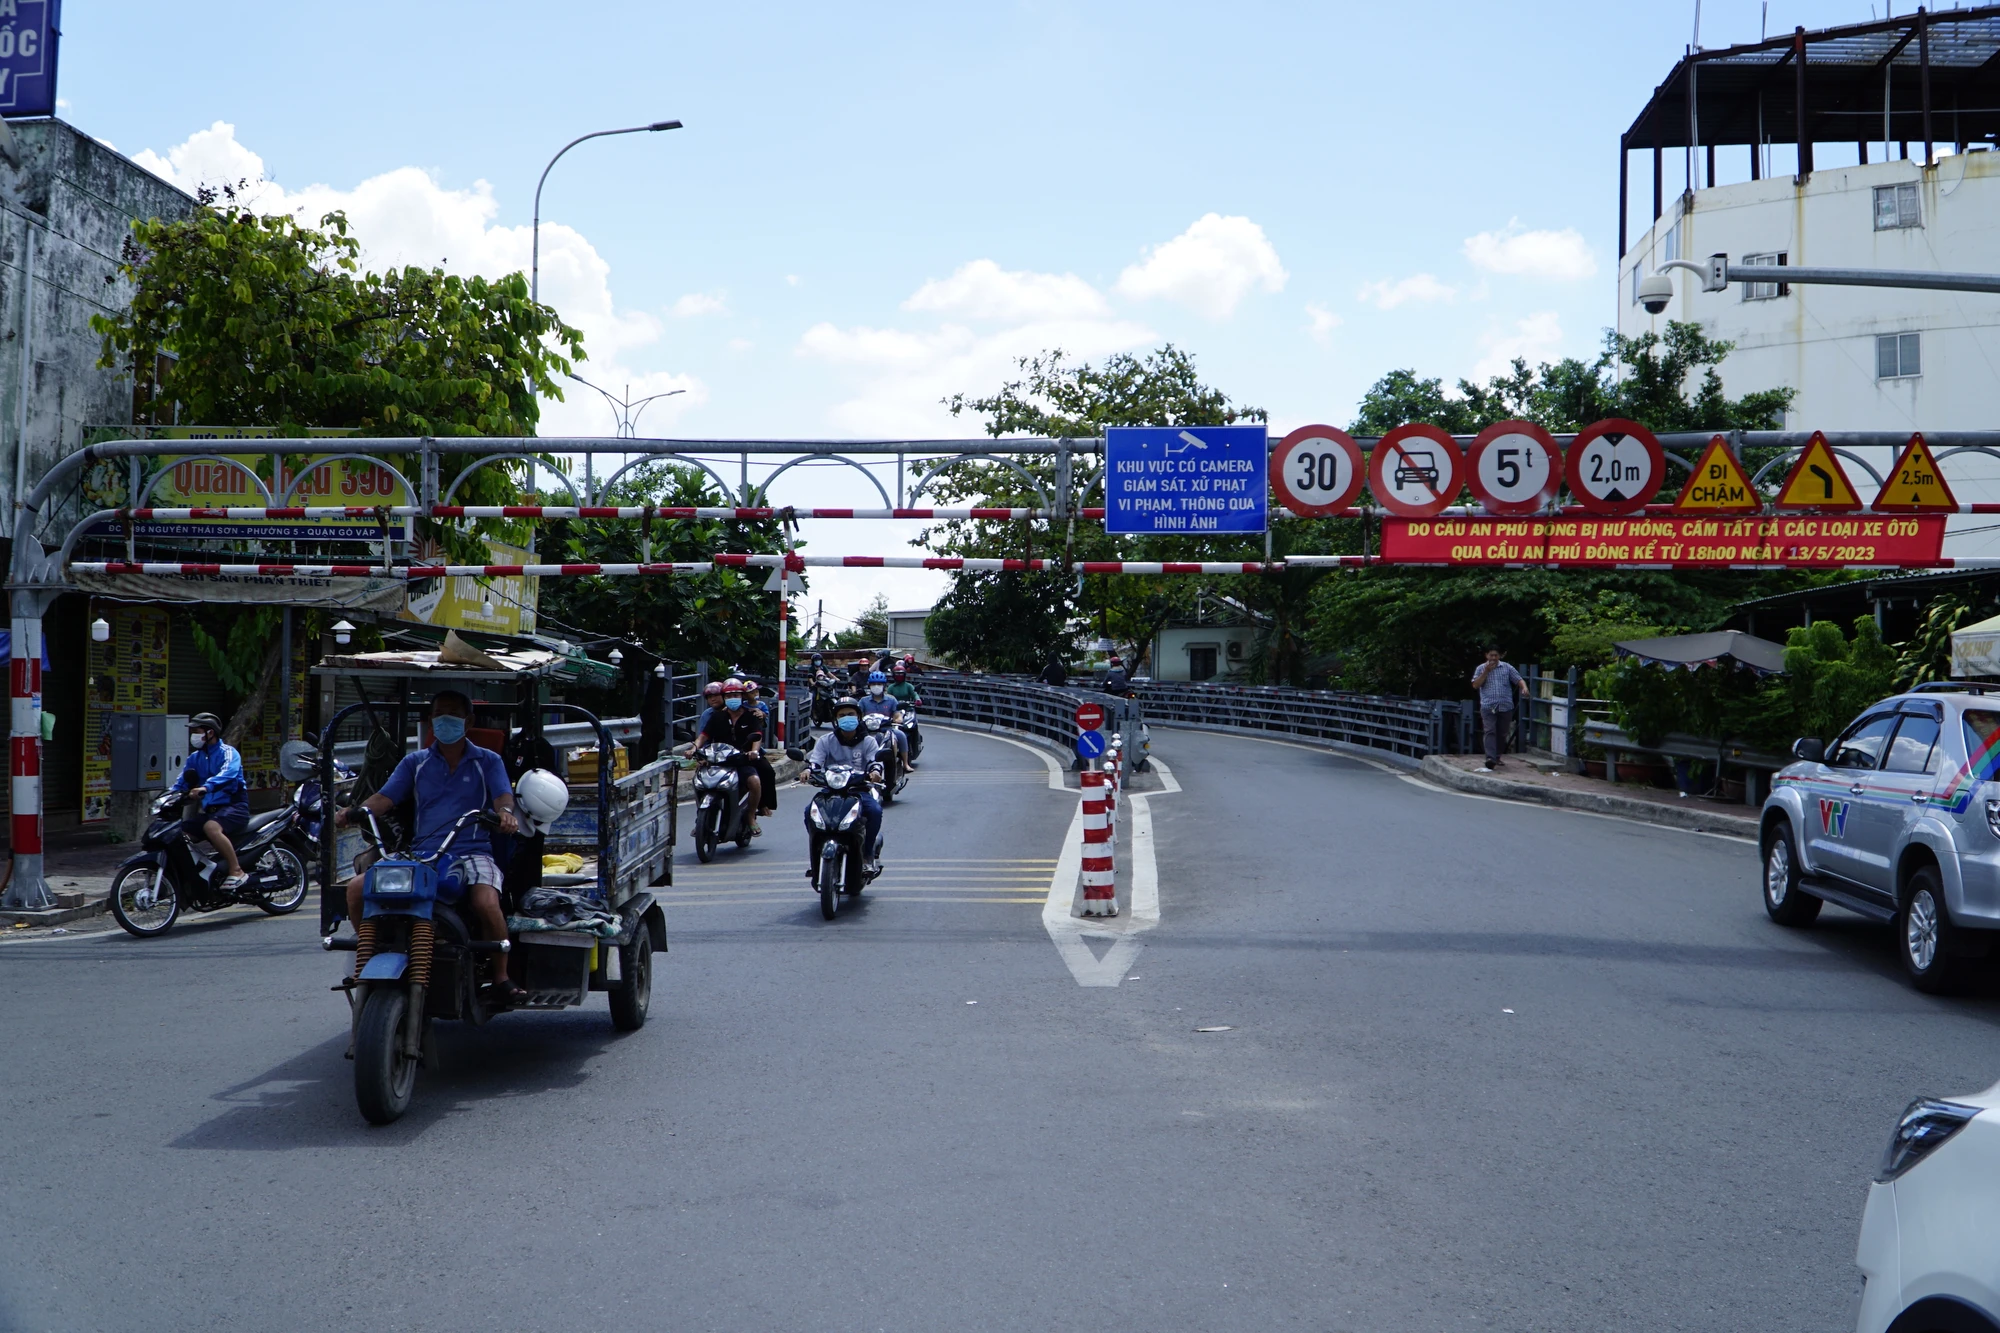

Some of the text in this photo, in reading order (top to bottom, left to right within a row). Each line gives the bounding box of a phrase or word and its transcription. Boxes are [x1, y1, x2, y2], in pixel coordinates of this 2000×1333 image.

[1117, 457, 1254, 475] KHU VỰC CÓ CAMERA
[1296, 452, 1337, 491] 30
[1709, 464, 1727, 480] ĐI
[340, 459, 395, 497] 396
[1124, 476, 1157, 492] GIÁM
[1191, 475, 1210, 492] XỬ
[1213, 478, 1247, 494] PHẠT
[1901, 470, 1934, 486] 2,5m
[1118, 498, 1131, 511] VI
[1180, 496, 1225, 511] THÔNG
[1229, 498, 1255, 511] QUA
[1691, 482, 1744, 506] CHẬM
[1154, 513, 1217, 529] HÌNH ẢNH
[1408, 517, 1919, 540] DO CẦU AN PHÚ ĐÔNG BỊ HƯ HỎNG, CẤM TẤT CẢ CÁC LOẠI XE ÔTÔ
[191, 525, 214, 534] THÁI
[217, 526, 238, 535] SƠN
[247, 526, 291, 535] PHƯỜNG
[307, 528, 335, 537] QUẬN
[338, 527, 353, 536] GÒ
[1451, 539, 1875, 562] QUA CẦU AN PHÚ ĐÔNG KỂ TỪ 18h00 NGÀY 13/5/2023
[1819, 797, 1851, 839] VTV
